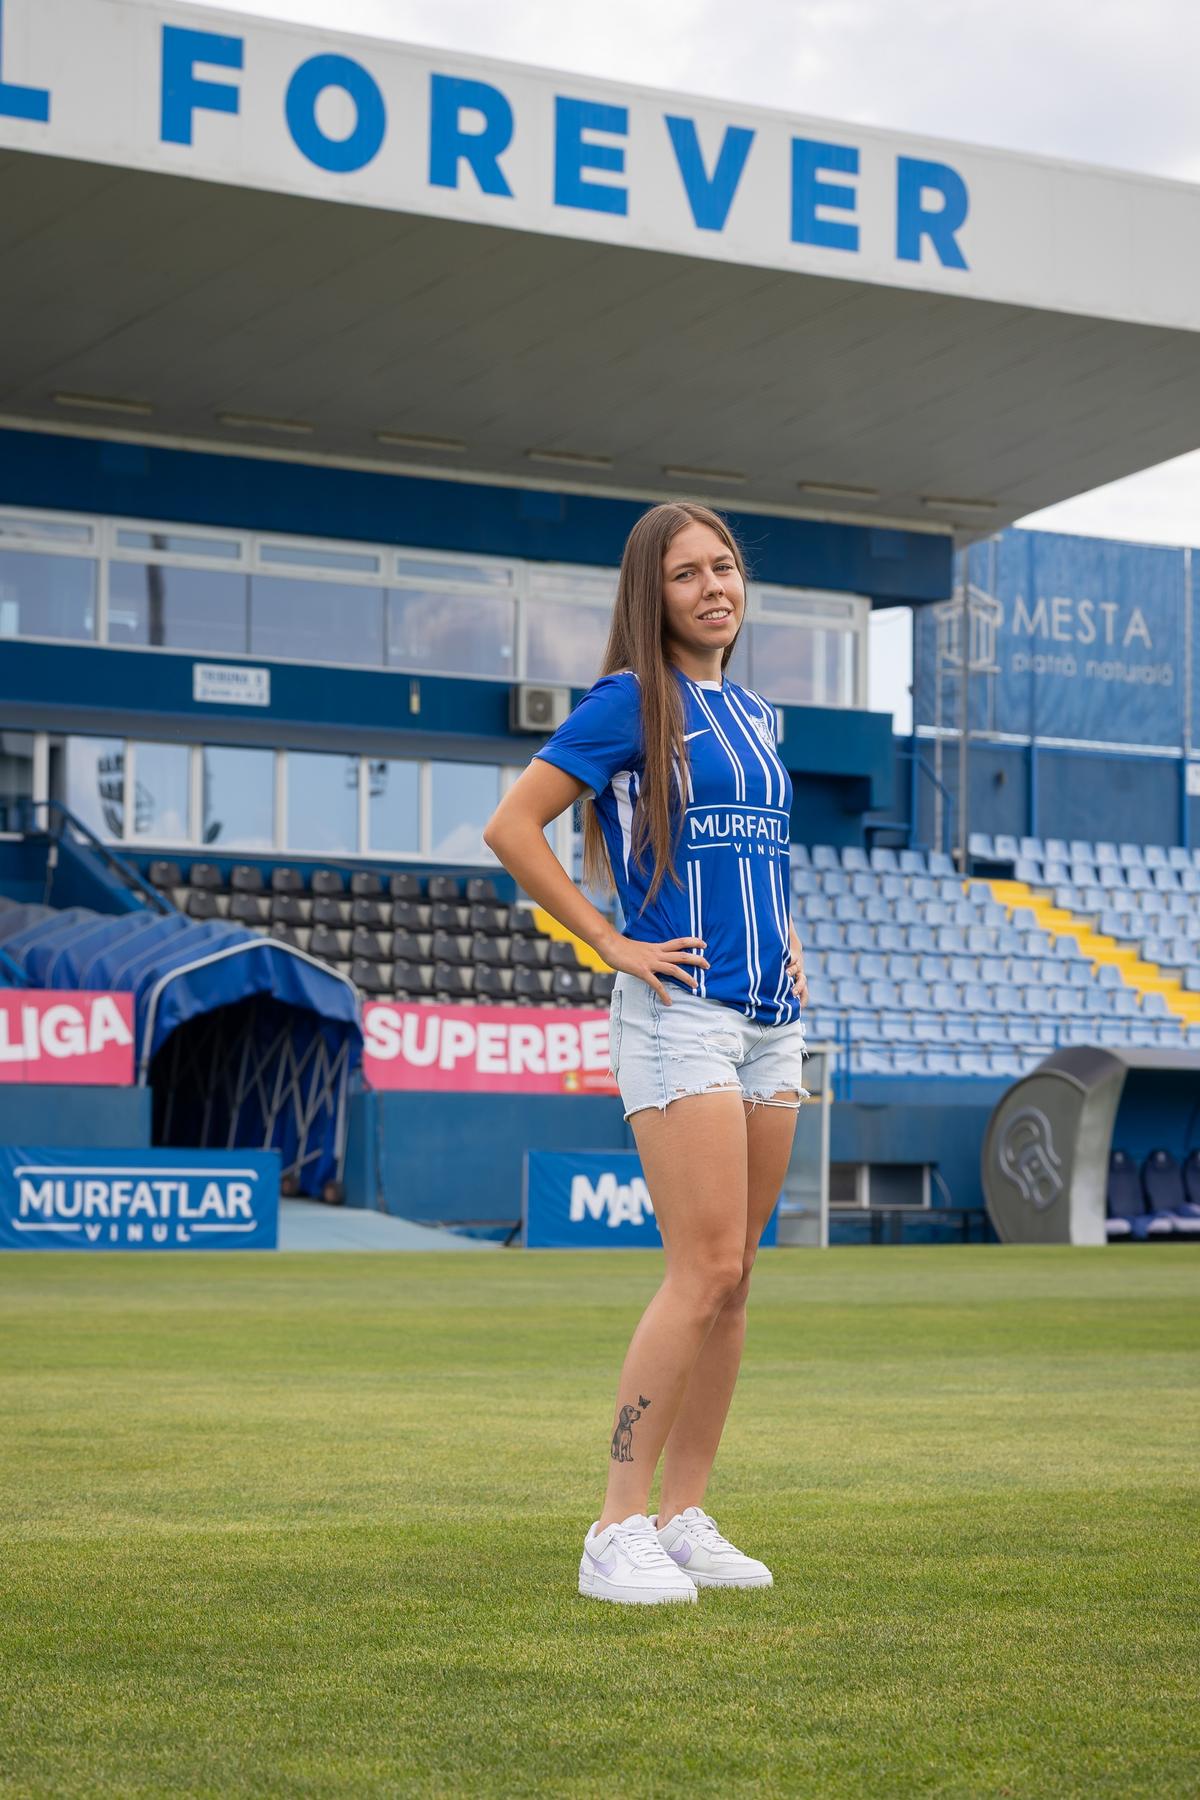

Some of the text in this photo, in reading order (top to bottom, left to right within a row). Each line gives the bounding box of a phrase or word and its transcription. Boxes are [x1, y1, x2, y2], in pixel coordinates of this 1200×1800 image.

[160, 24, 970, 271] FOREVER
[1011, 594, 1152, 649] MESTA
[0, 996, 133, 1062] LIGA
[19, 1179, 253, 1218] MURFATLAR
[85, 1223, 191, 1242] VINUL
